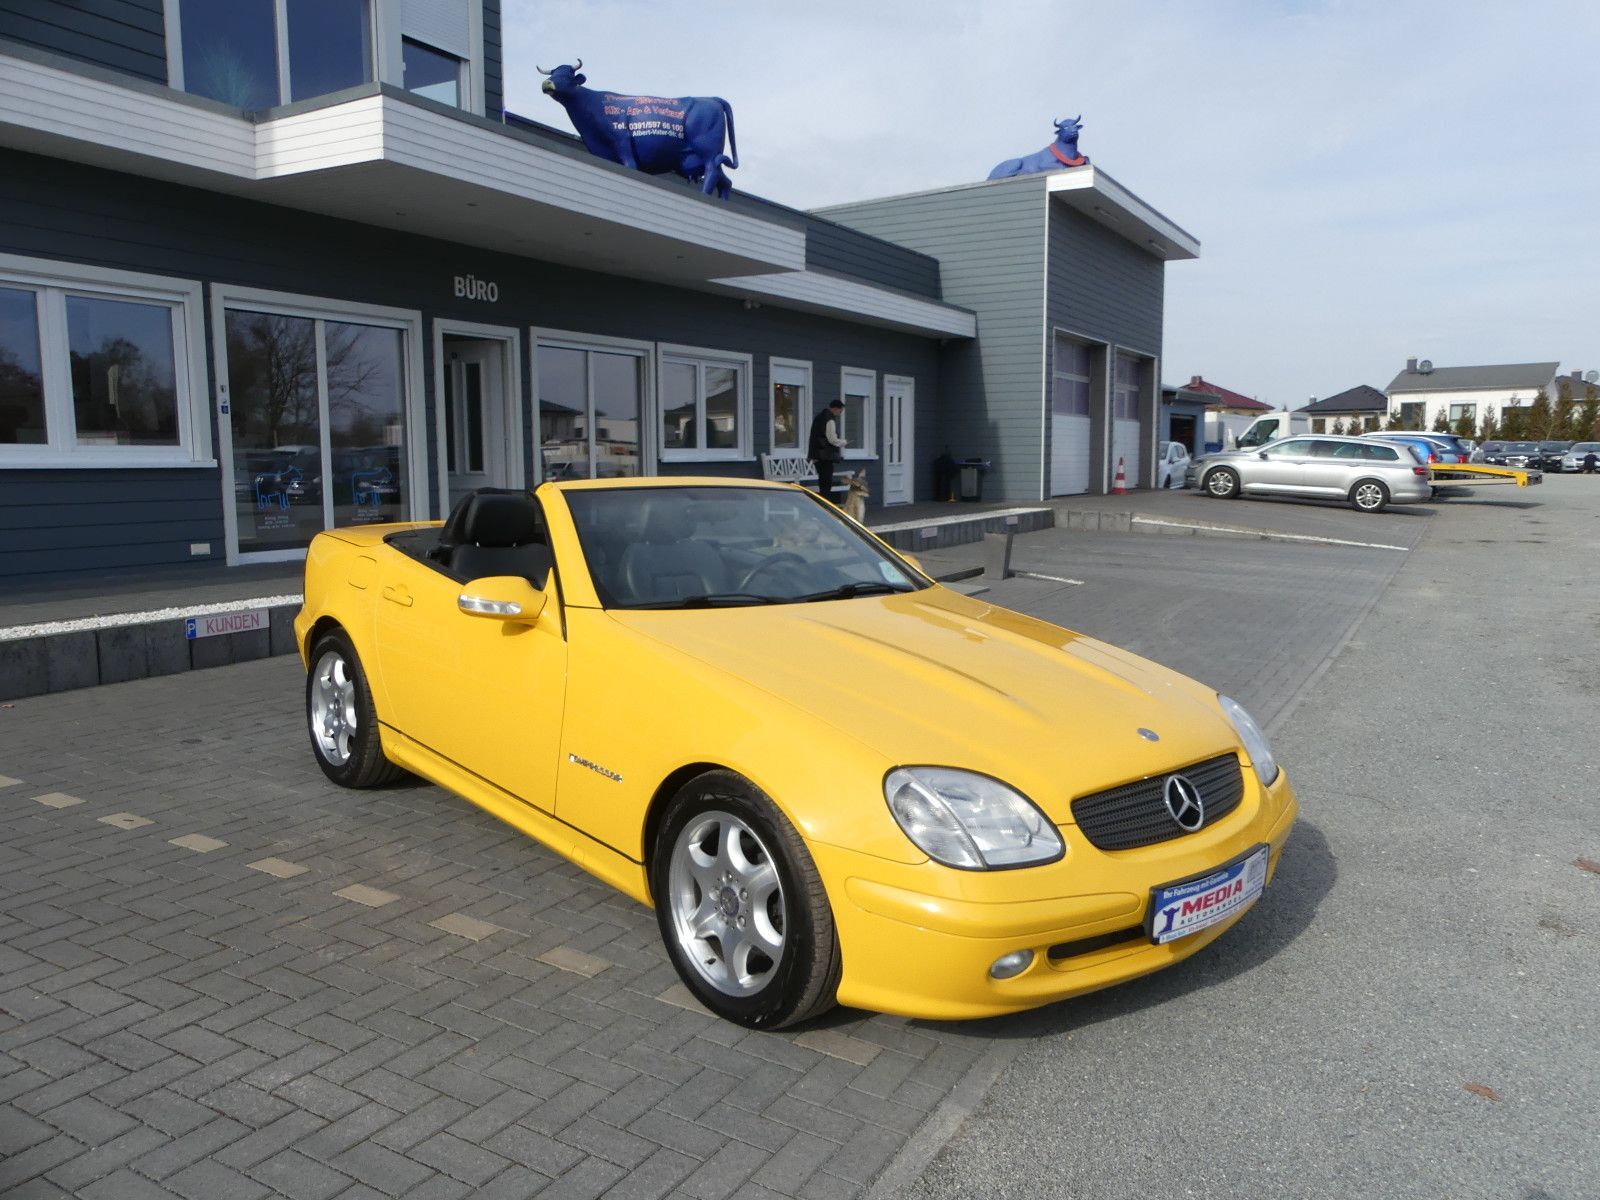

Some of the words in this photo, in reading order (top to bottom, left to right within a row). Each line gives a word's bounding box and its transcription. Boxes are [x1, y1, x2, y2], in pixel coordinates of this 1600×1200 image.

[613, 122, 627, 130] Tel.
[454, 274, 498, 302] BÜRO
[206, 613, 259, 634] KUNDEN
[1180, 896, 1241, 925] AUTOHANDEL
[1181, 878, 1243, 917] MEDIA
